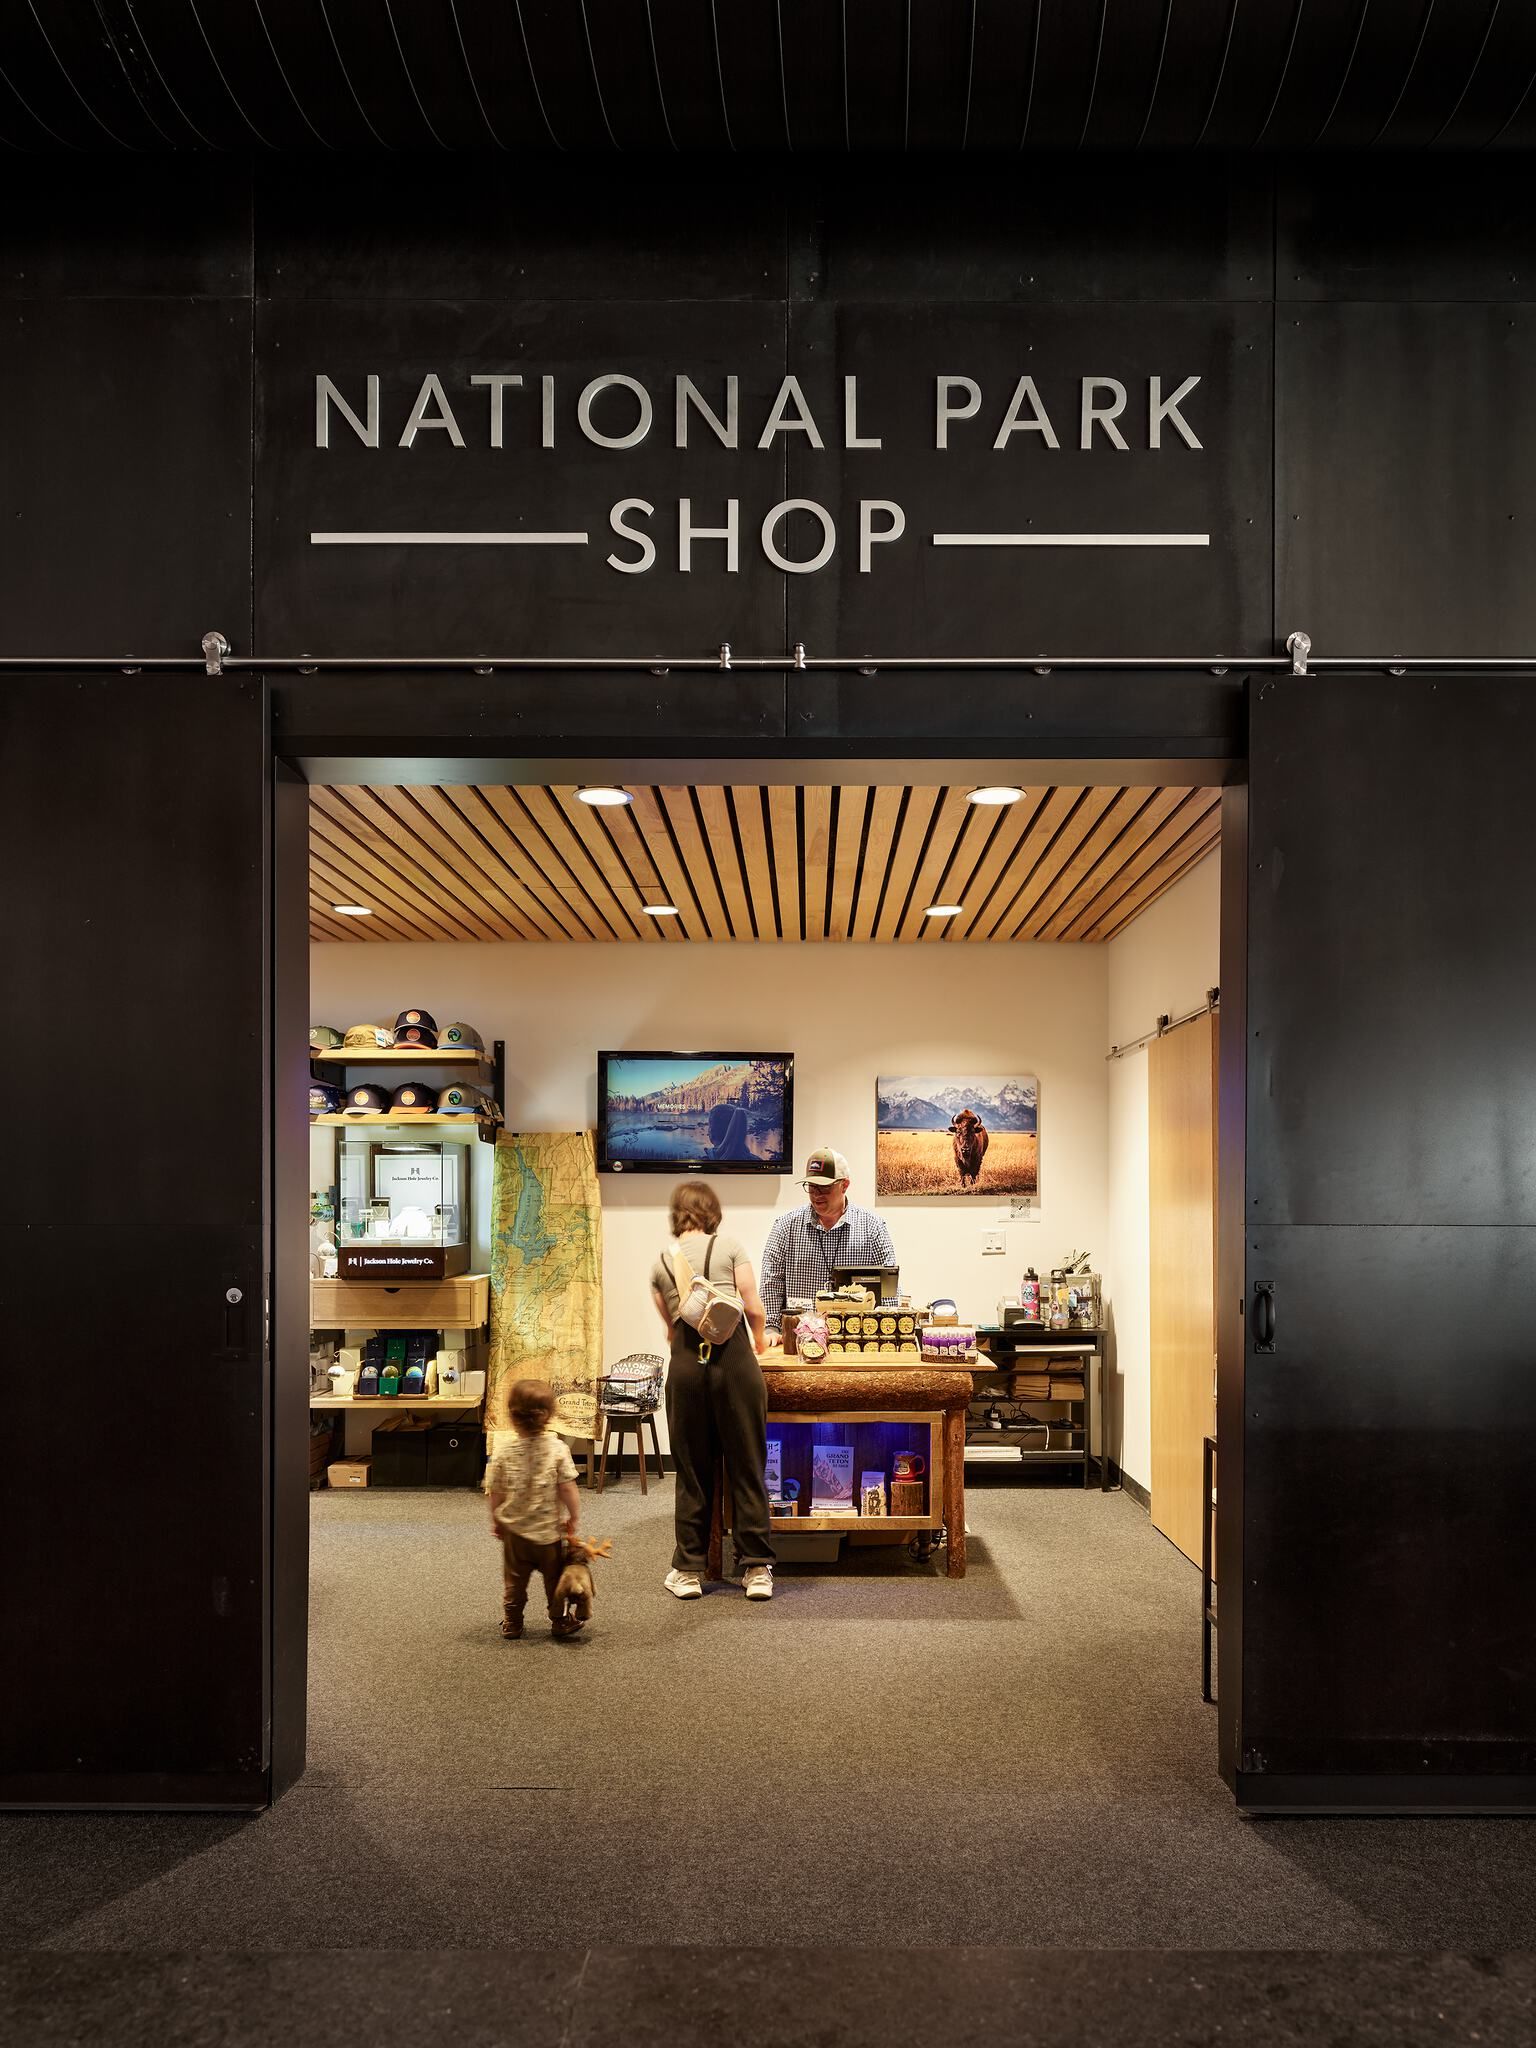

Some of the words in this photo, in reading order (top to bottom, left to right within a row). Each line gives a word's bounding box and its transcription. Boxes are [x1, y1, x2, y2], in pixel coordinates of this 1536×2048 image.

[316, 374, 882, 450] NATIONAL
[937, 375, 1204, 450] PARK
[607, 498, 906, 574] SHOP
[364, 1257, 386, 1265] Jackson
[387, 1257, 401, 1265] Hole
[402, 1257, 423, 1266] Jewelry
[423, 1257, 434, 1265] Co.
[558, 1397, 580, 1406] Grand
